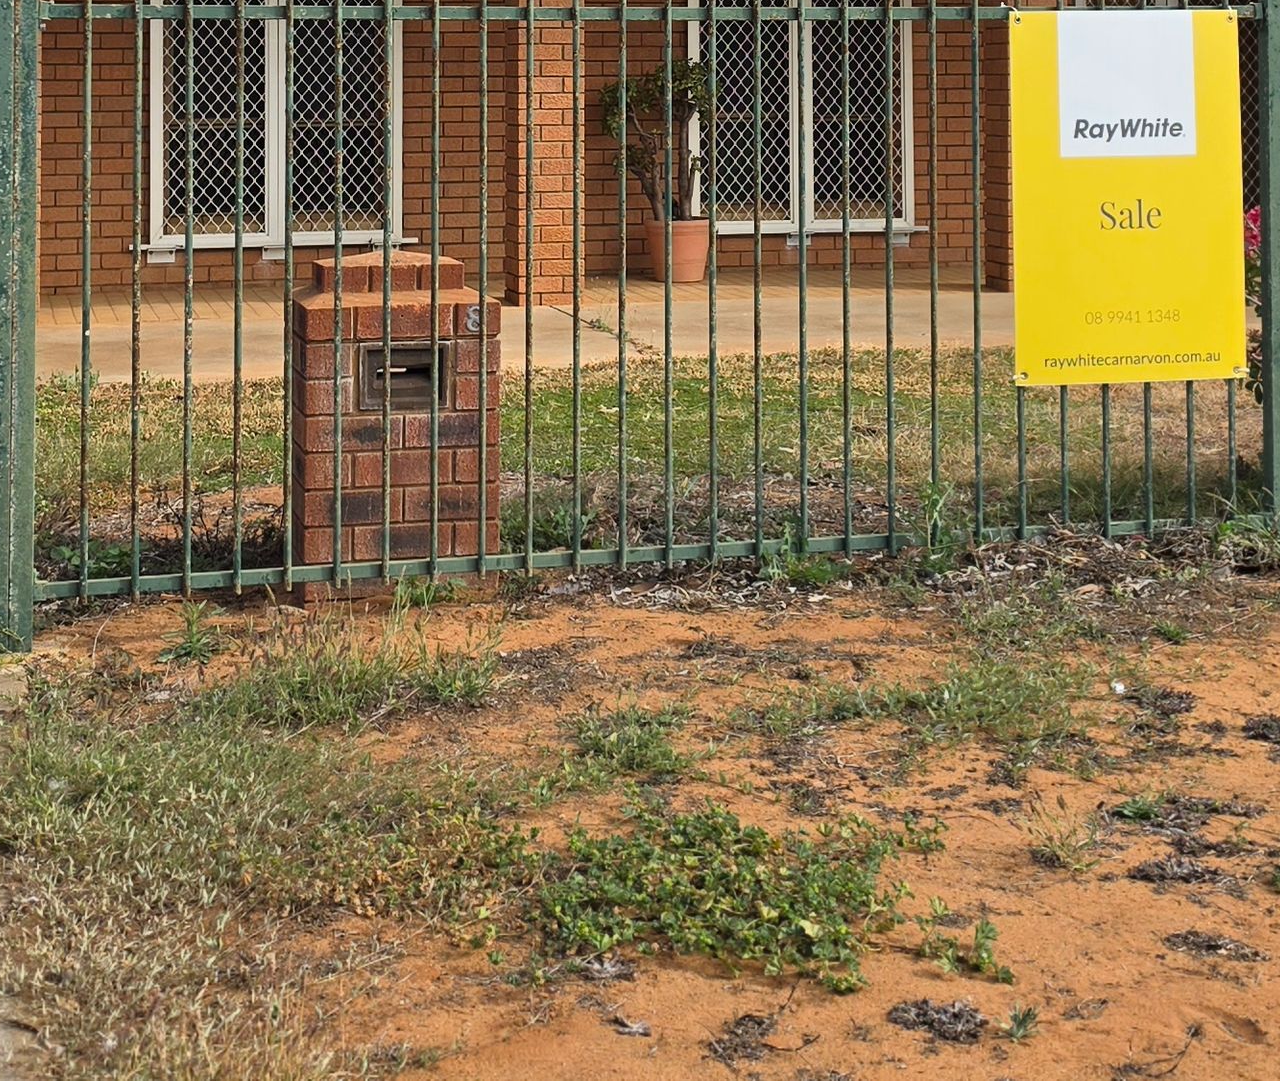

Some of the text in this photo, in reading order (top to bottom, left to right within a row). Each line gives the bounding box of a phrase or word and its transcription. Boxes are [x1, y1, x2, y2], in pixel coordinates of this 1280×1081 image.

[1099, 198, 1162, 230] Sale
[1084, 308, 1181, 326] 08 9941 1348
[1044, 351, 1221, 370] raywhitecarnarvon.com.au
